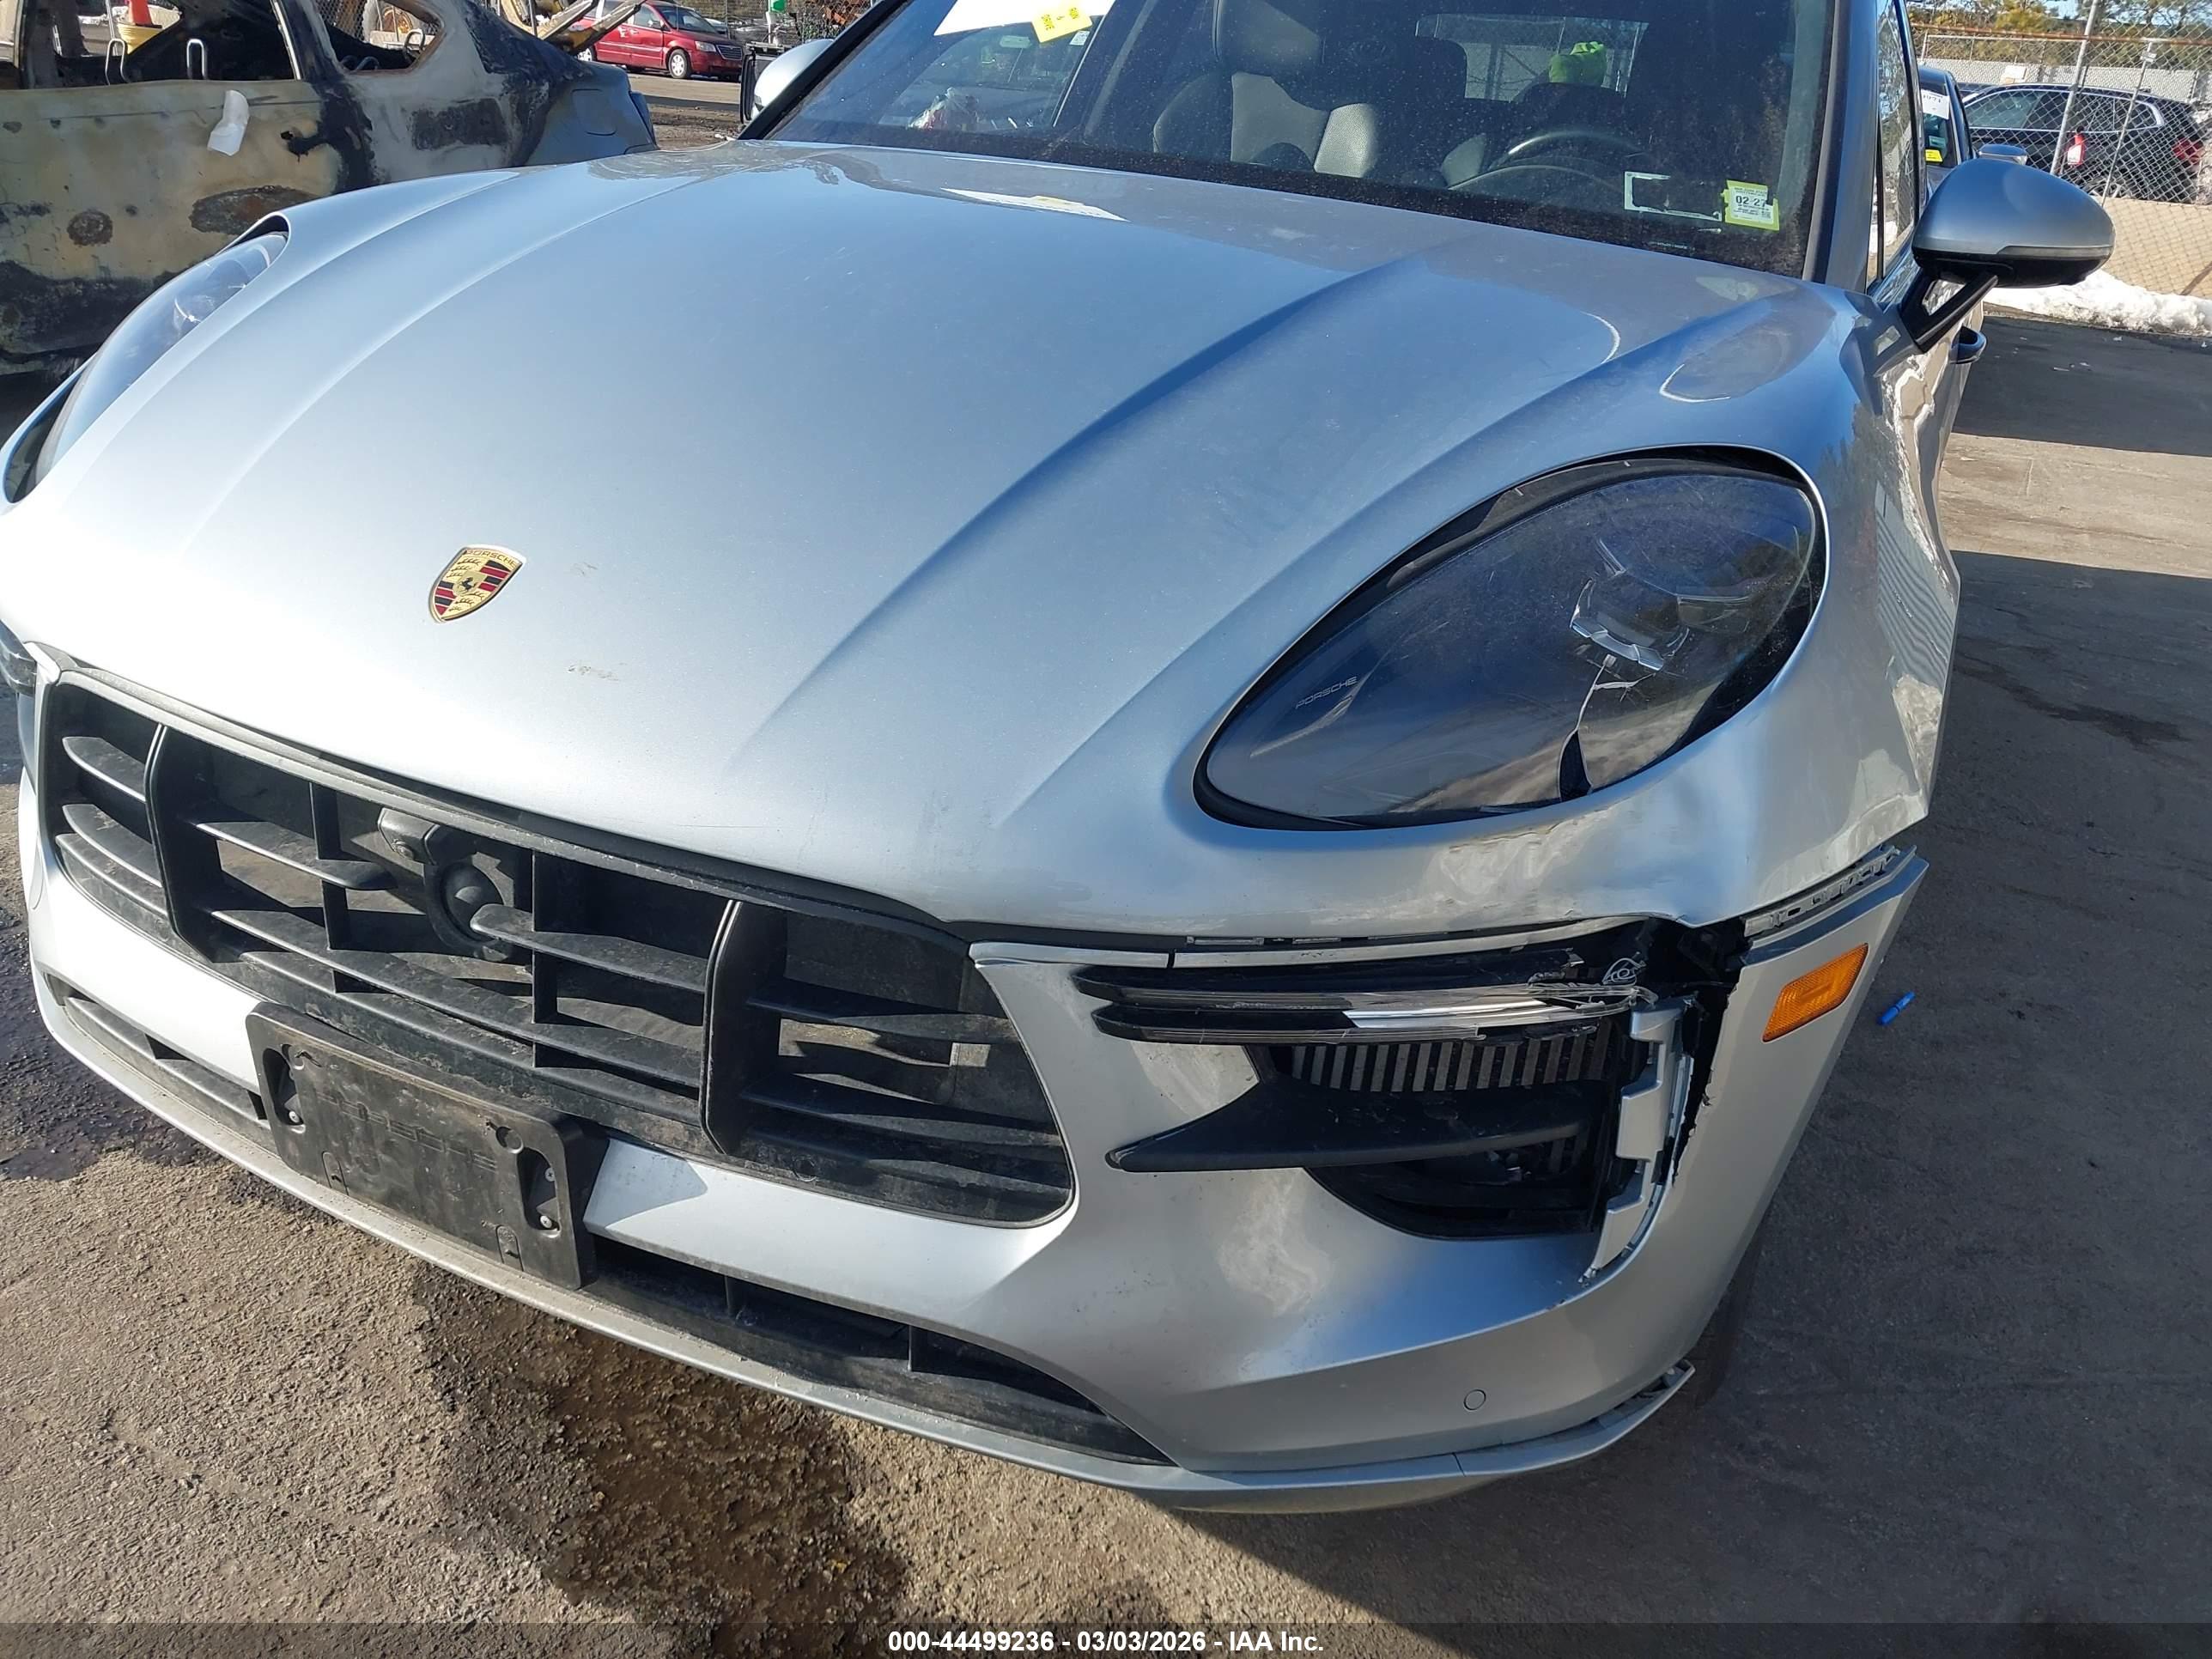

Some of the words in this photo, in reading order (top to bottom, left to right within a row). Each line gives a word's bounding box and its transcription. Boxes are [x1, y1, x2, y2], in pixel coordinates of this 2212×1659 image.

[1041, 14, 1055, 31] DRIVE
[1735, 195, 1749, 205] 02
[465, 550, 517, 568] PORSCHE
[1295, 676, 1358, 710] PORSCHE
